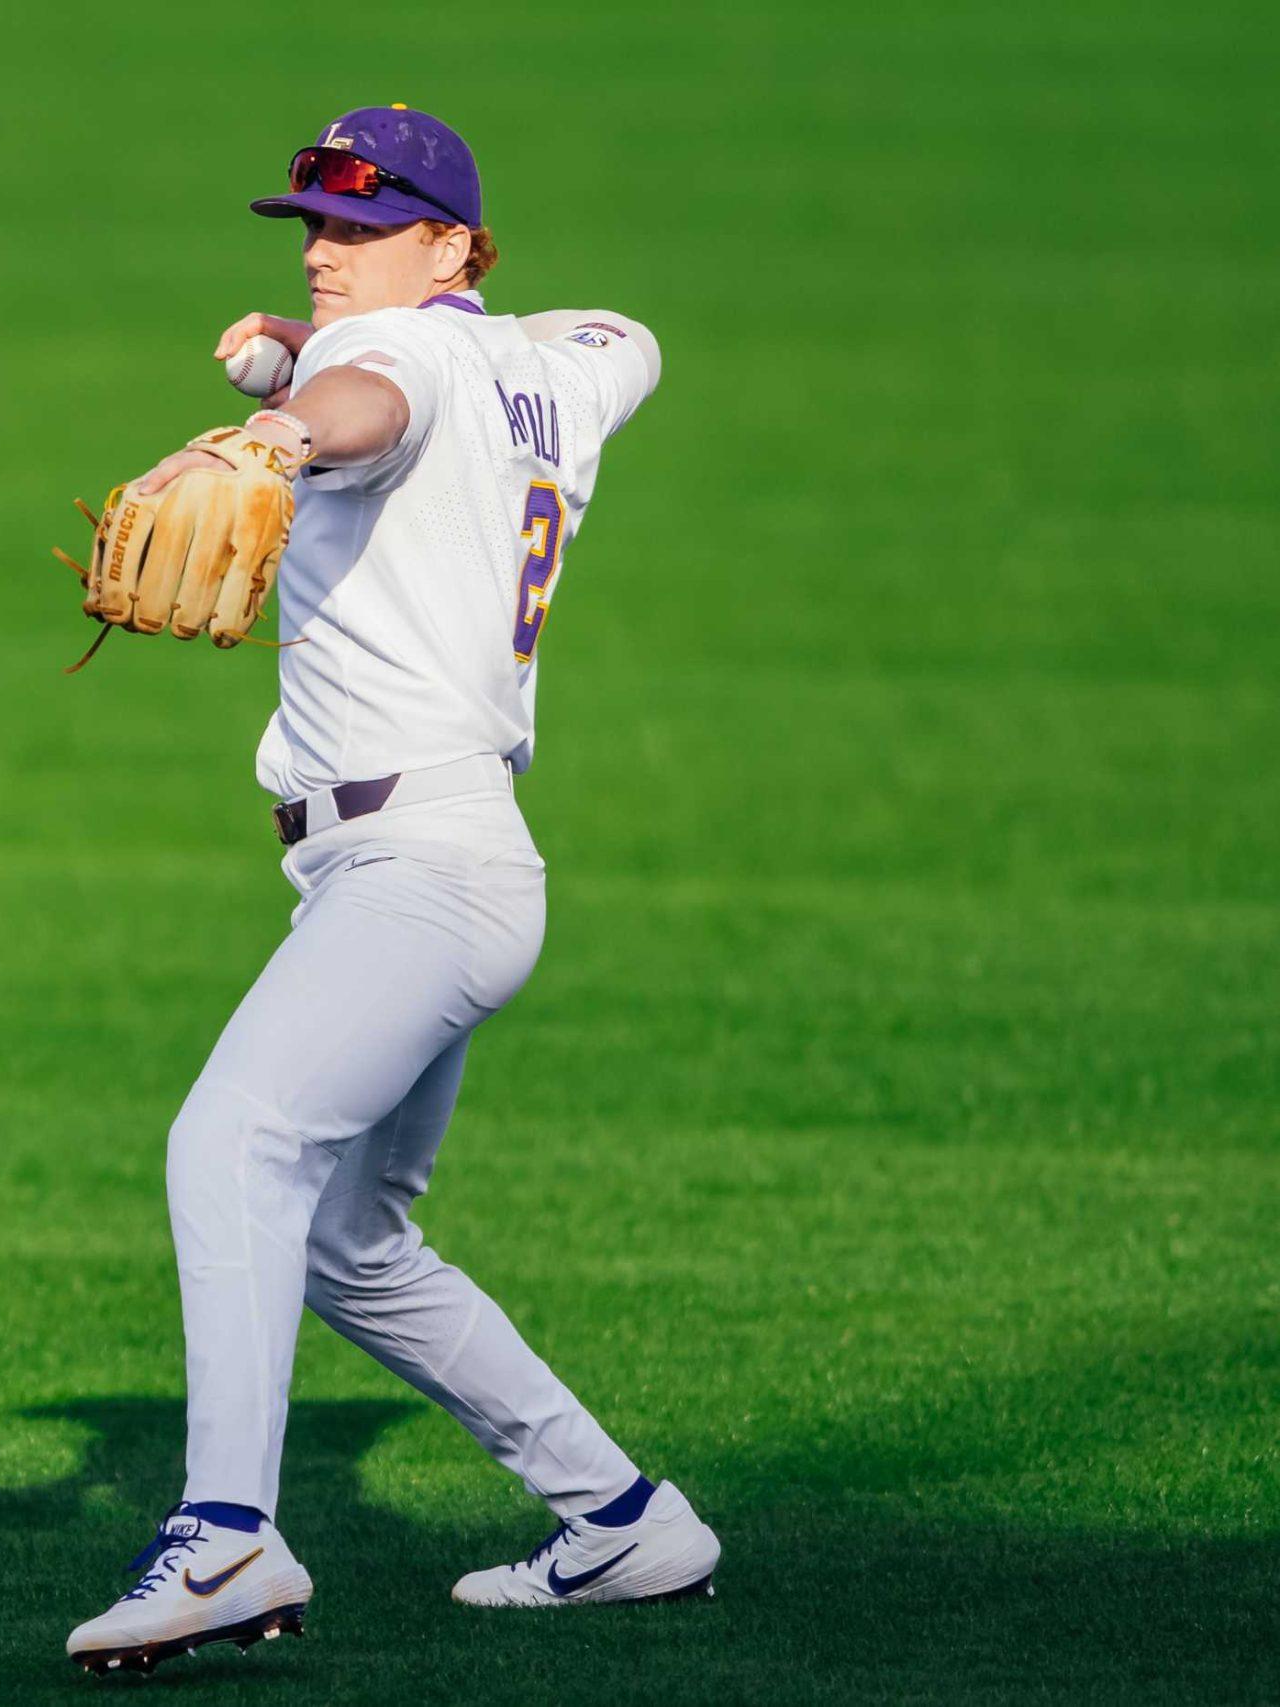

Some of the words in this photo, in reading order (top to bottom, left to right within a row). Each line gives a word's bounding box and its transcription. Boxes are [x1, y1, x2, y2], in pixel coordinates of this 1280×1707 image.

[109, 500, 139, 582] marucci
[513, 479, 565, 664] 2
[170, 1523, 195, 1536] NIKE
